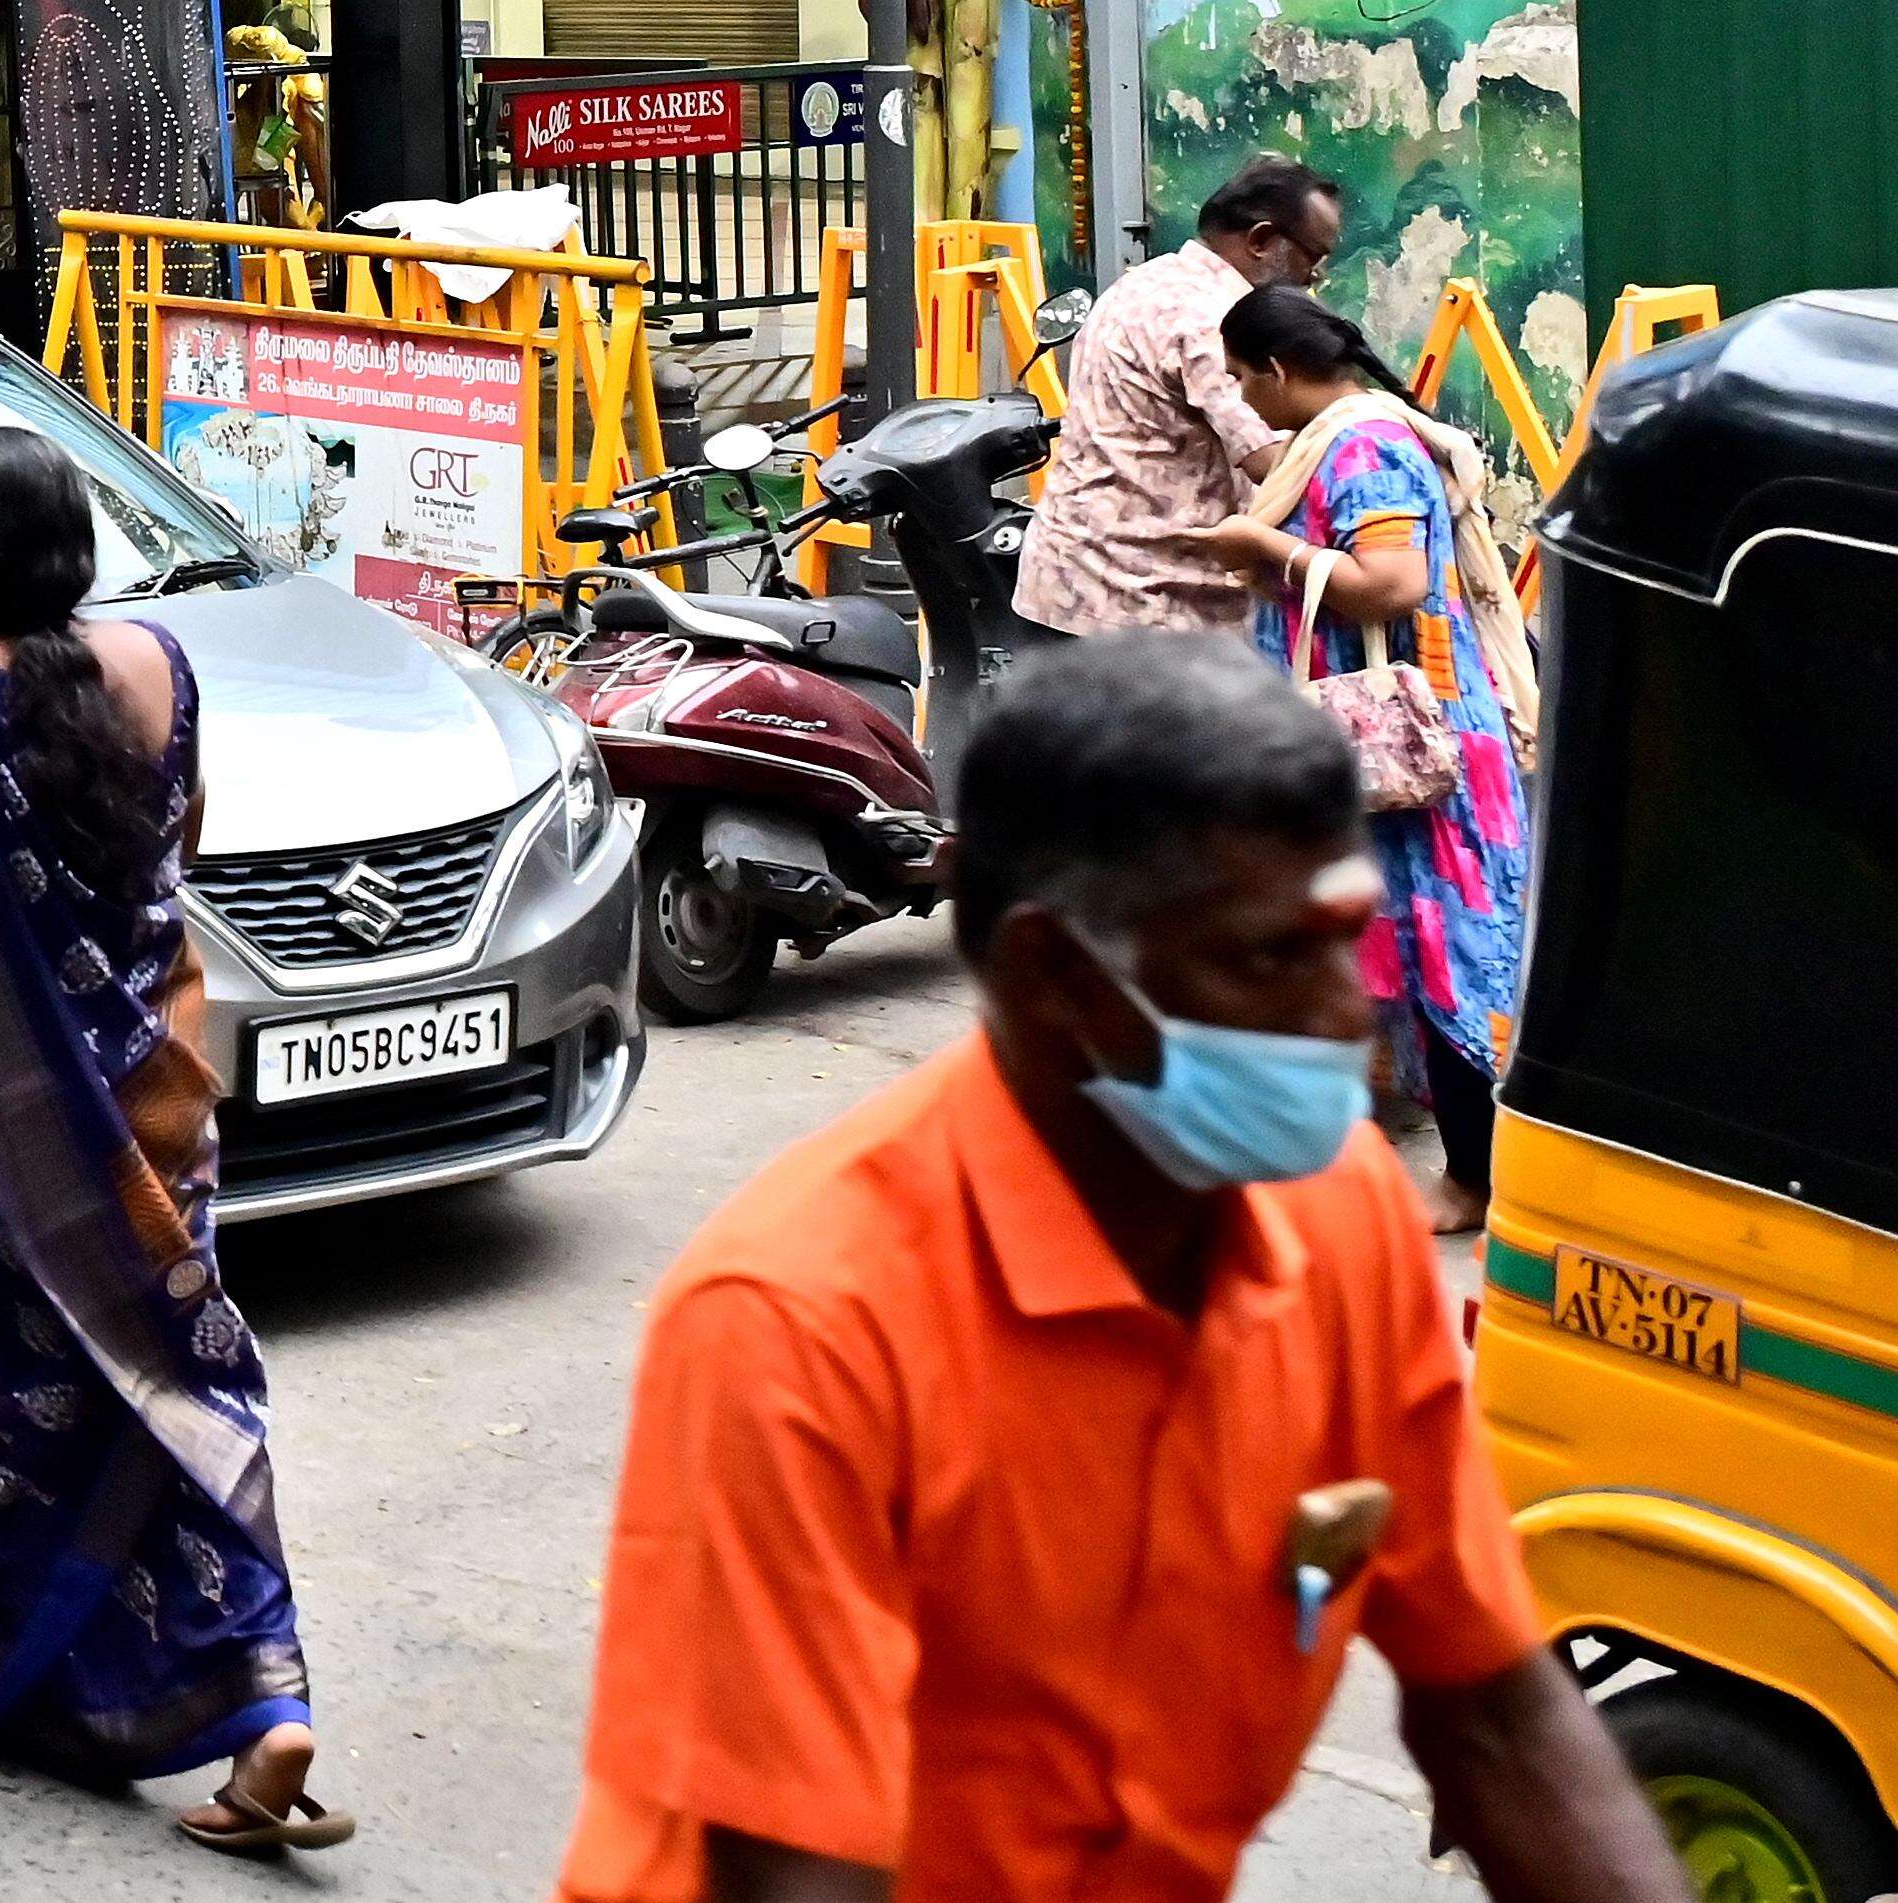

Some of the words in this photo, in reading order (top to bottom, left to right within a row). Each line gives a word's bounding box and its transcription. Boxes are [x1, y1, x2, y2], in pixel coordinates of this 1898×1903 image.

[524, 100, 572, 159] Nalli
[579, 96, 633, 125] SILK
[638, 89, 726, 121] SAREES
[842, 102, 857, 116] SRI
[553, 138, 575, 155] 100
[254, 326, 331, 366] திருமலை
[332, 334, 401, 379] திருப்பதி
[402, 340, 522, 387] தேவஸ்தானம்
[416, 394, 464, 417] சாலை
[409, 446, 480, 498] GRT
[281, 1007, 502, 1085] TN05BC9451
